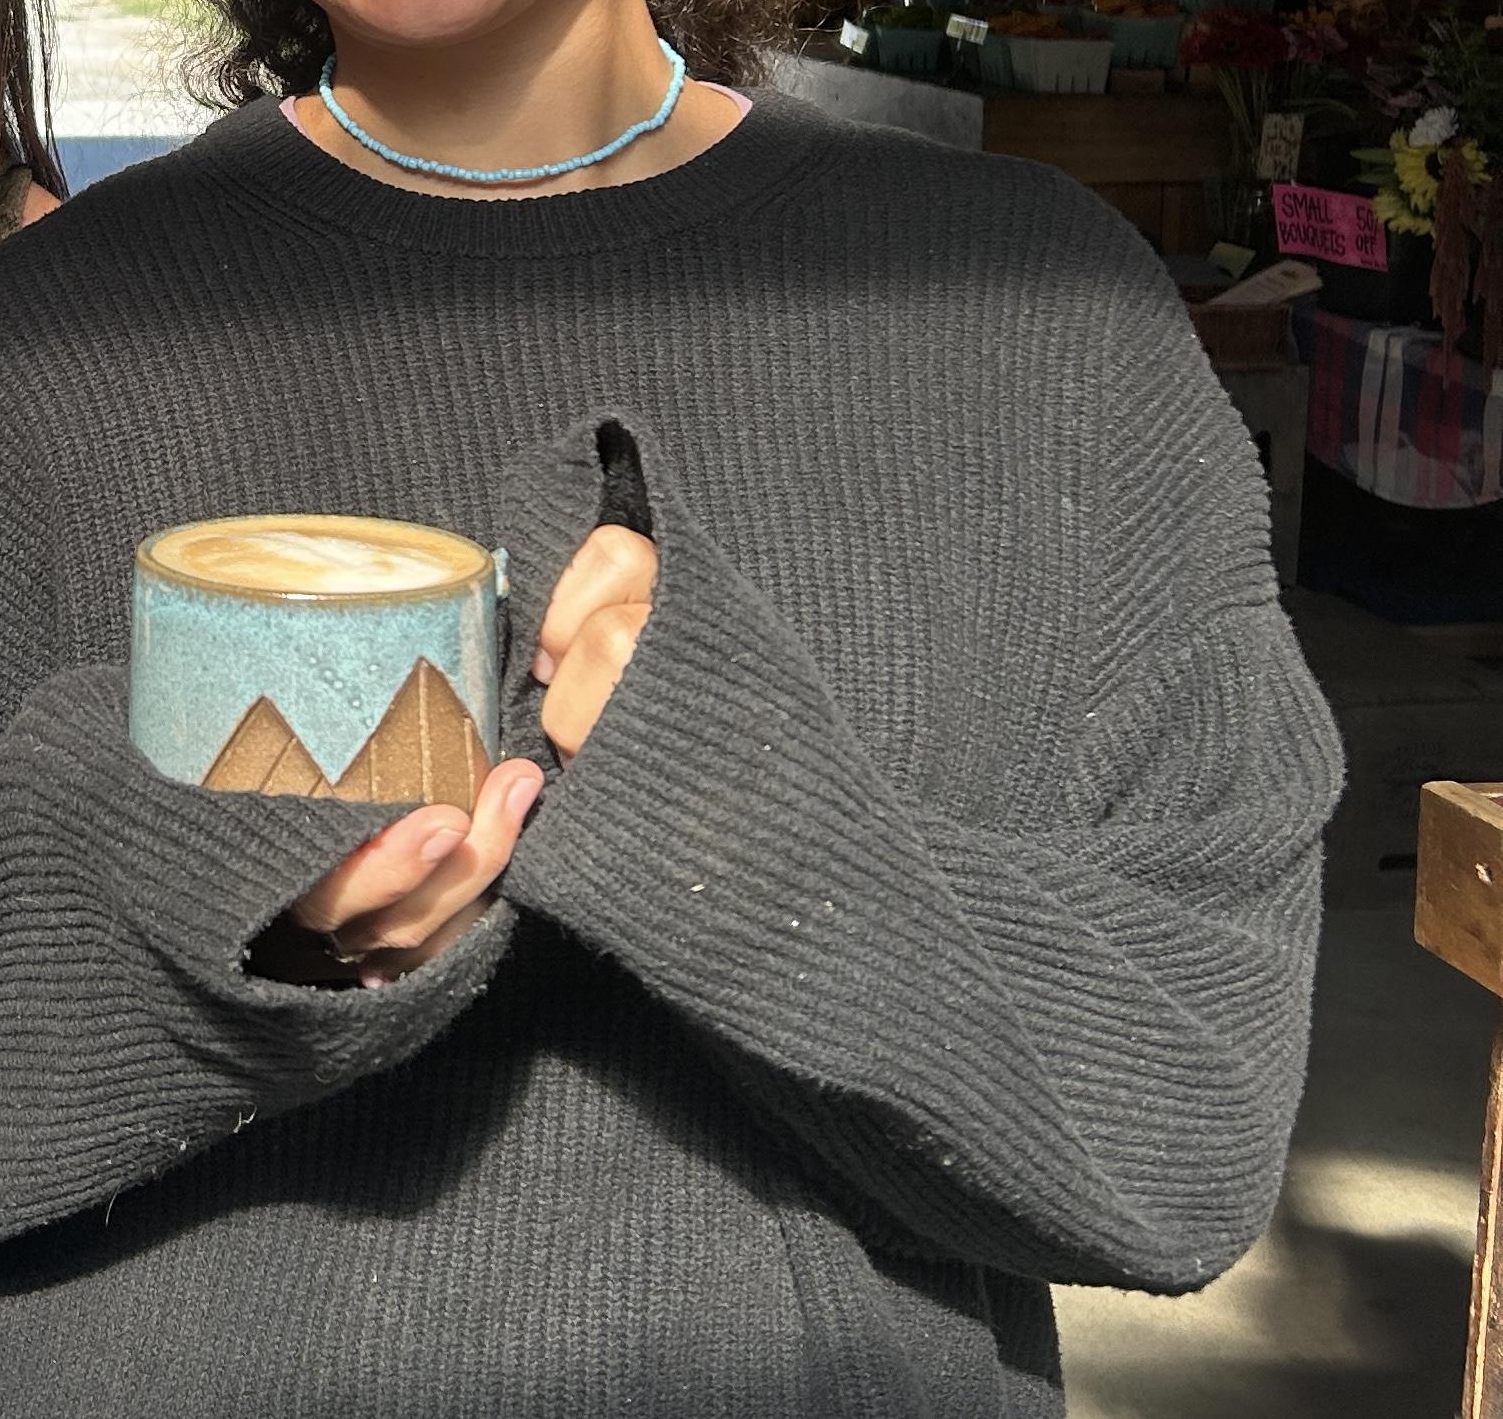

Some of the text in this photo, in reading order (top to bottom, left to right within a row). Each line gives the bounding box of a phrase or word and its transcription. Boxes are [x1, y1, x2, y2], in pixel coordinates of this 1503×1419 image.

[1281, 193, 1379, 237] SMALL 50
[1279, 222, 1378, 257] BOUQUETS OFF
